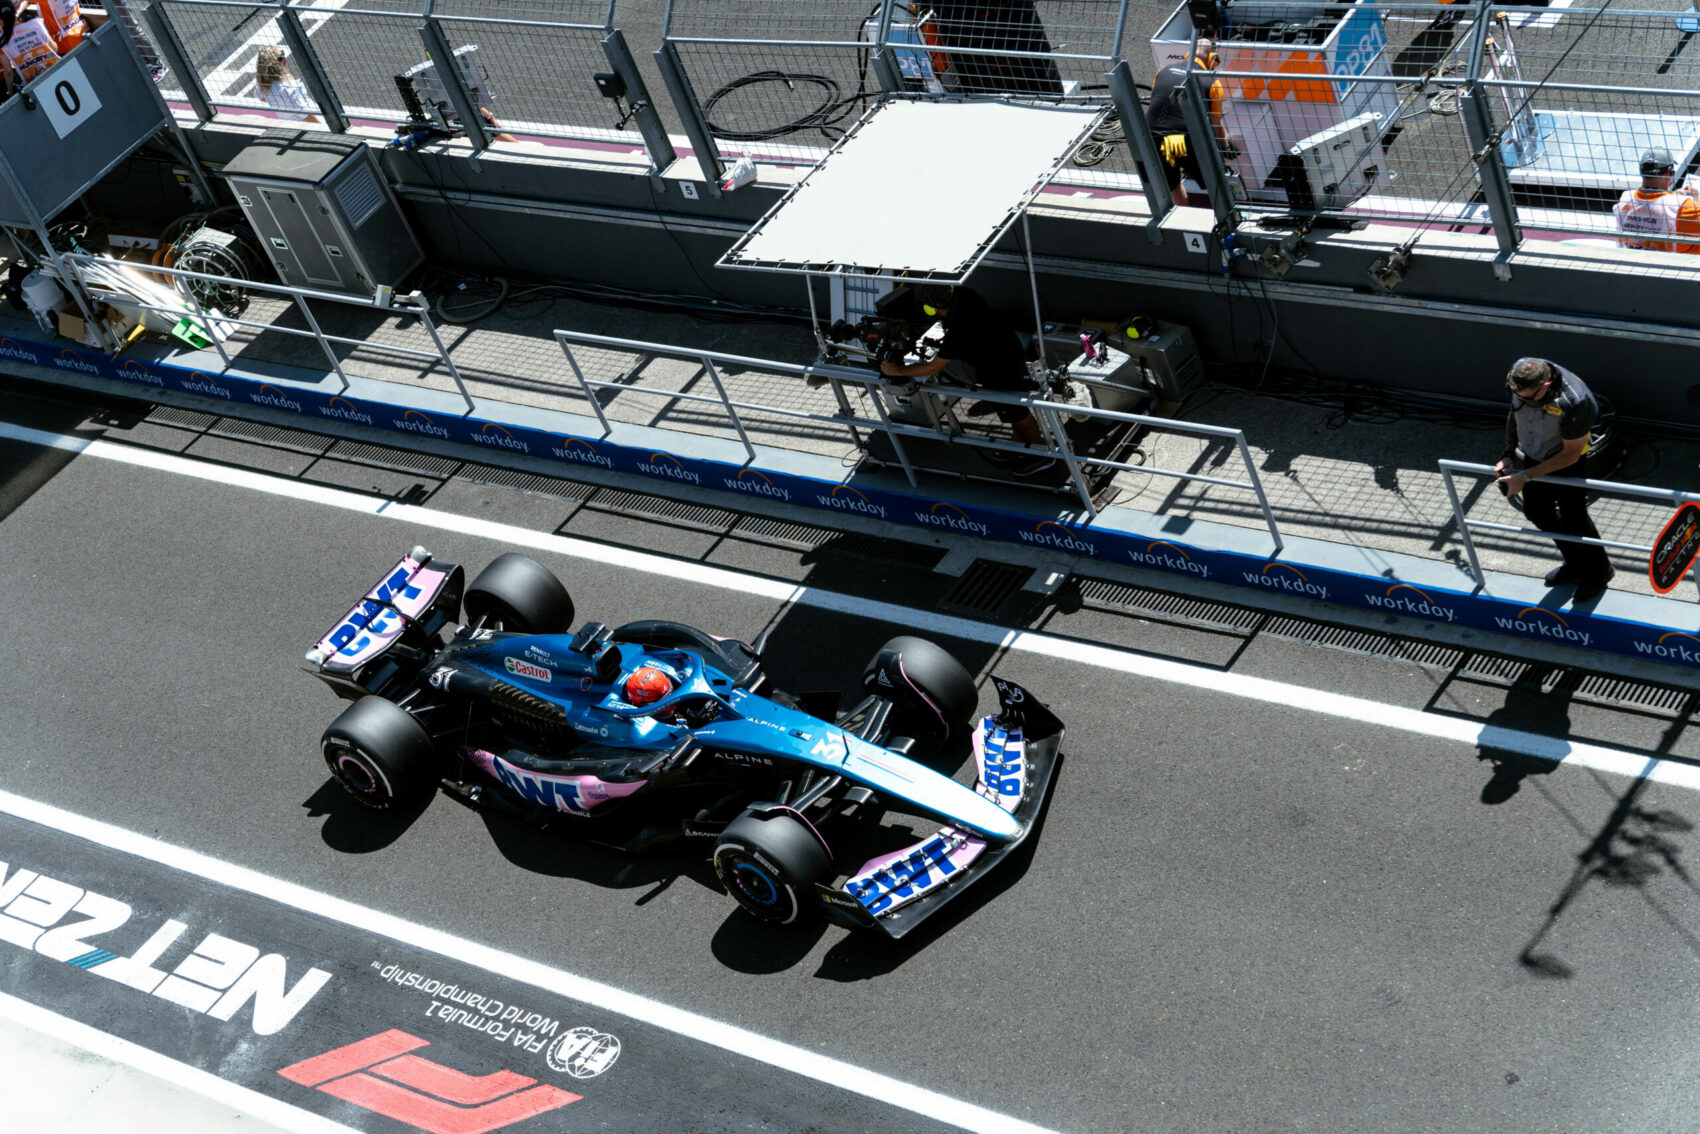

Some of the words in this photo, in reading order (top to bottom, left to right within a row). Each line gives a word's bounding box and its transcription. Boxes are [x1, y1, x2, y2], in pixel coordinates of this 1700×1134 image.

[55, 80, 80, 116] 0
[685, 185, 693, 196] 5
[1191, 237, 1200, 249] 4
[53, 357, 99, 375] workday
[116, 368, 164, 387] workday
[181, 380, 230, 399] workday
[250, 392, 301, 412] workday
[319, 405, 372, 424] workday
[393, 418, 448, 438] workday
[470, 431, 529, 452] workday
[552, 447, 612, 468] workday
[637, 461, 700, 484] workday
[724, 477, 790, 501] workday
[816, 494, 885, 518] workday
[914, 510, 988, 535] workday
[1018, 529, 1095, 555] workday
[1656, 511, 1695, 564] ORACLE
[1128, 549, 1209, 577] workday
[1243, 571, 1327, 598] workday
[329, 567, 422, 657] BWT
[1365, 593, 1454, 621] workday
[1494, 616, 1591, 645] workday
[524, 650, 558, 668] E-TECH
[515, 661, 549, 681] Castrol
[746, 717, 787, 732] ALPINE
[810, 731, 843, 760] 31
[714, 752, 773, 766] ALPINE
[846, 837, 957, 915] BWT
[831, 897, 859, 909] Microsoft
[87, 919, 333, 1036] NET
[425, 1001, 441, 1017] 1
[438, 1005, 515, 1042] Formula
[500, 1005, 559, 1037] World
[513, 1030, 548, 1053] FIA
